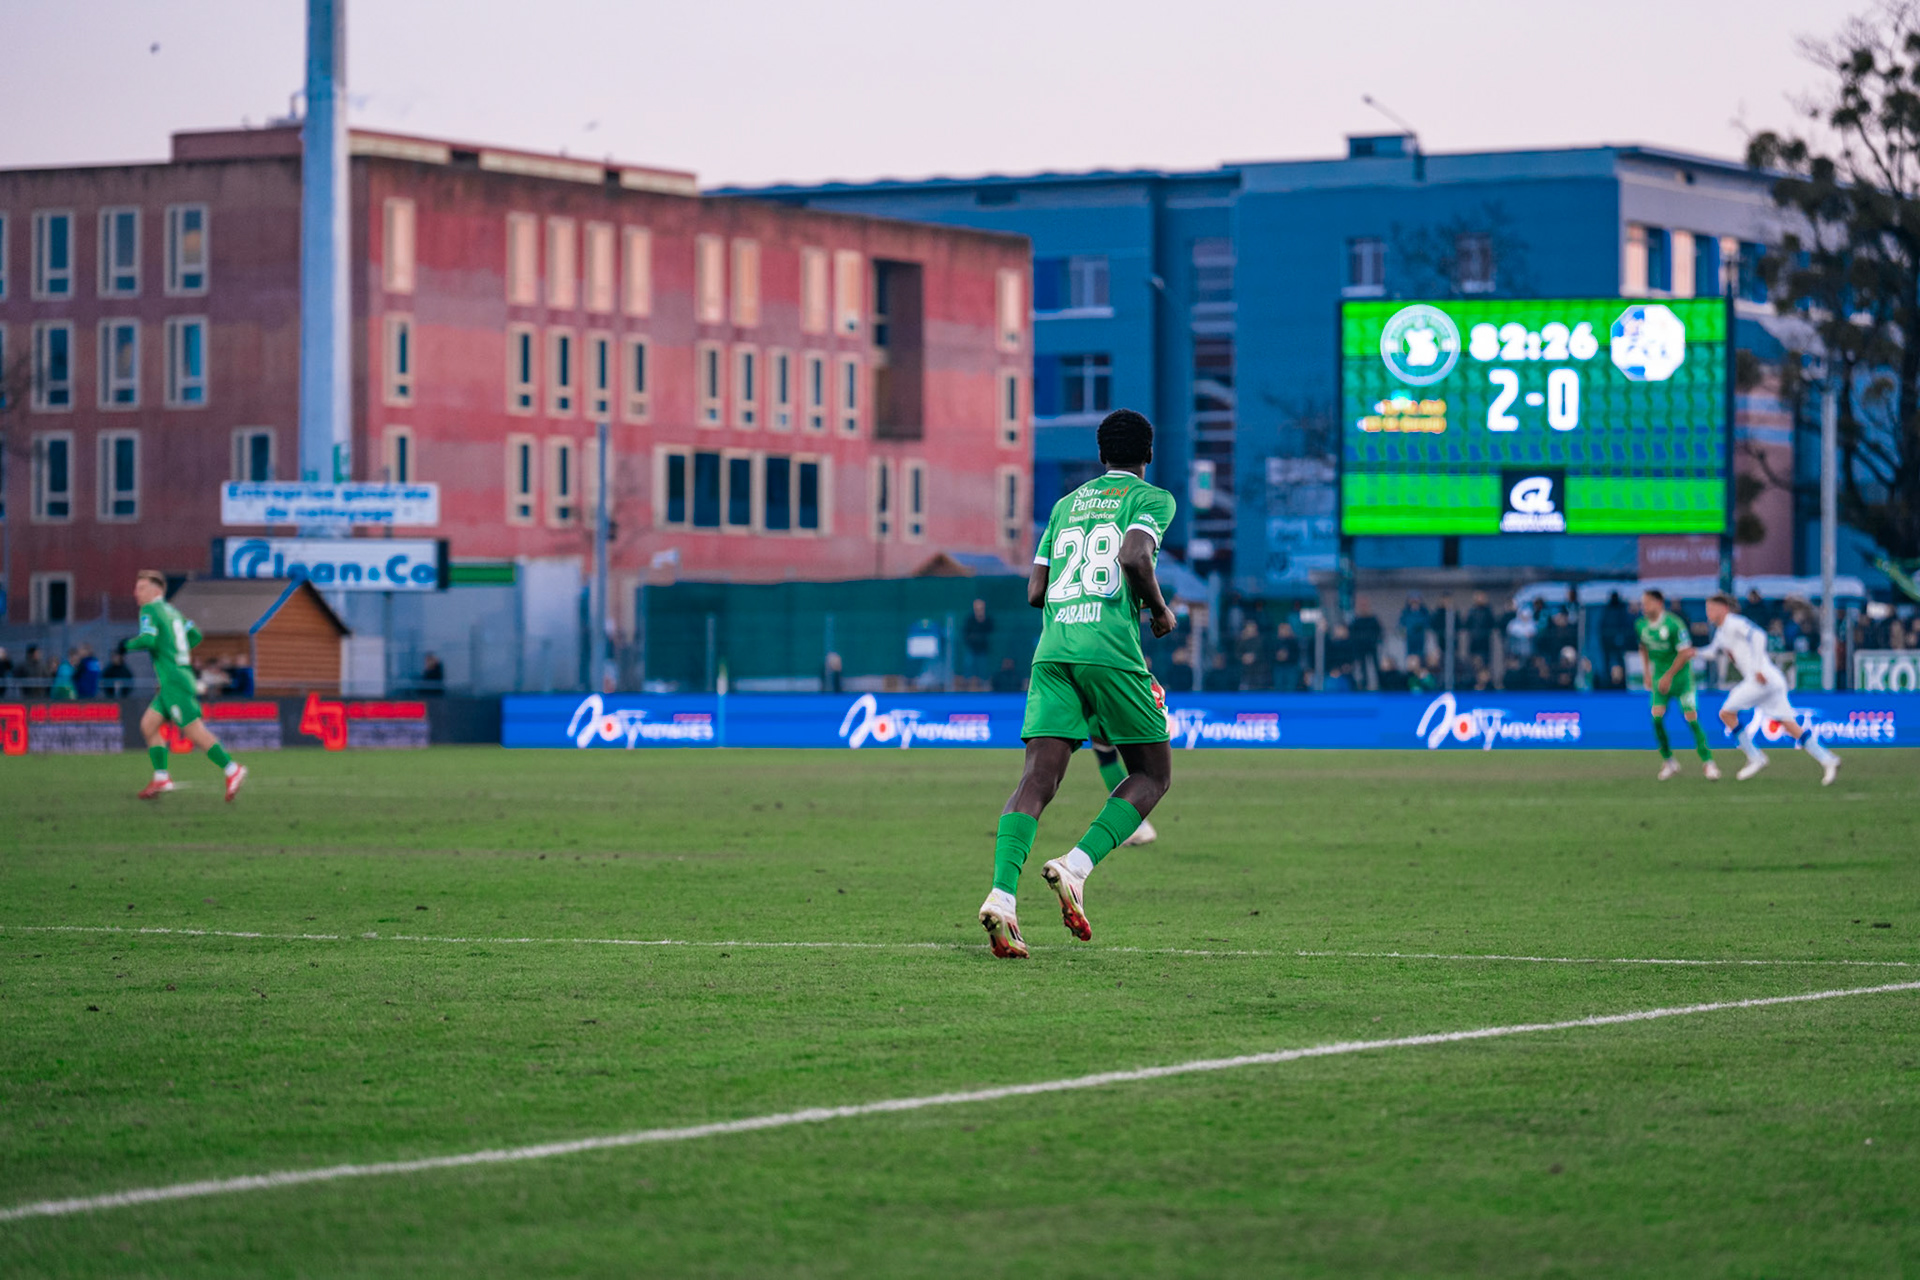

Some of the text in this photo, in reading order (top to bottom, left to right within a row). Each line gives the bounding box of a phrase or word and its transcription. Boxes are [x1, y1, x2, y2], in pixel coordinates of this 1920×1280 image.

[1469, 322, 1598, 361] 82:26
[1102, 485, 1129, 497] and
[1071, 497, 1121, 513] Partners
[1090, 511, 1116, 520] Services
[1048, 522, 1123, 602] 28
[1054, 602, 1103, 624] BARADJI
